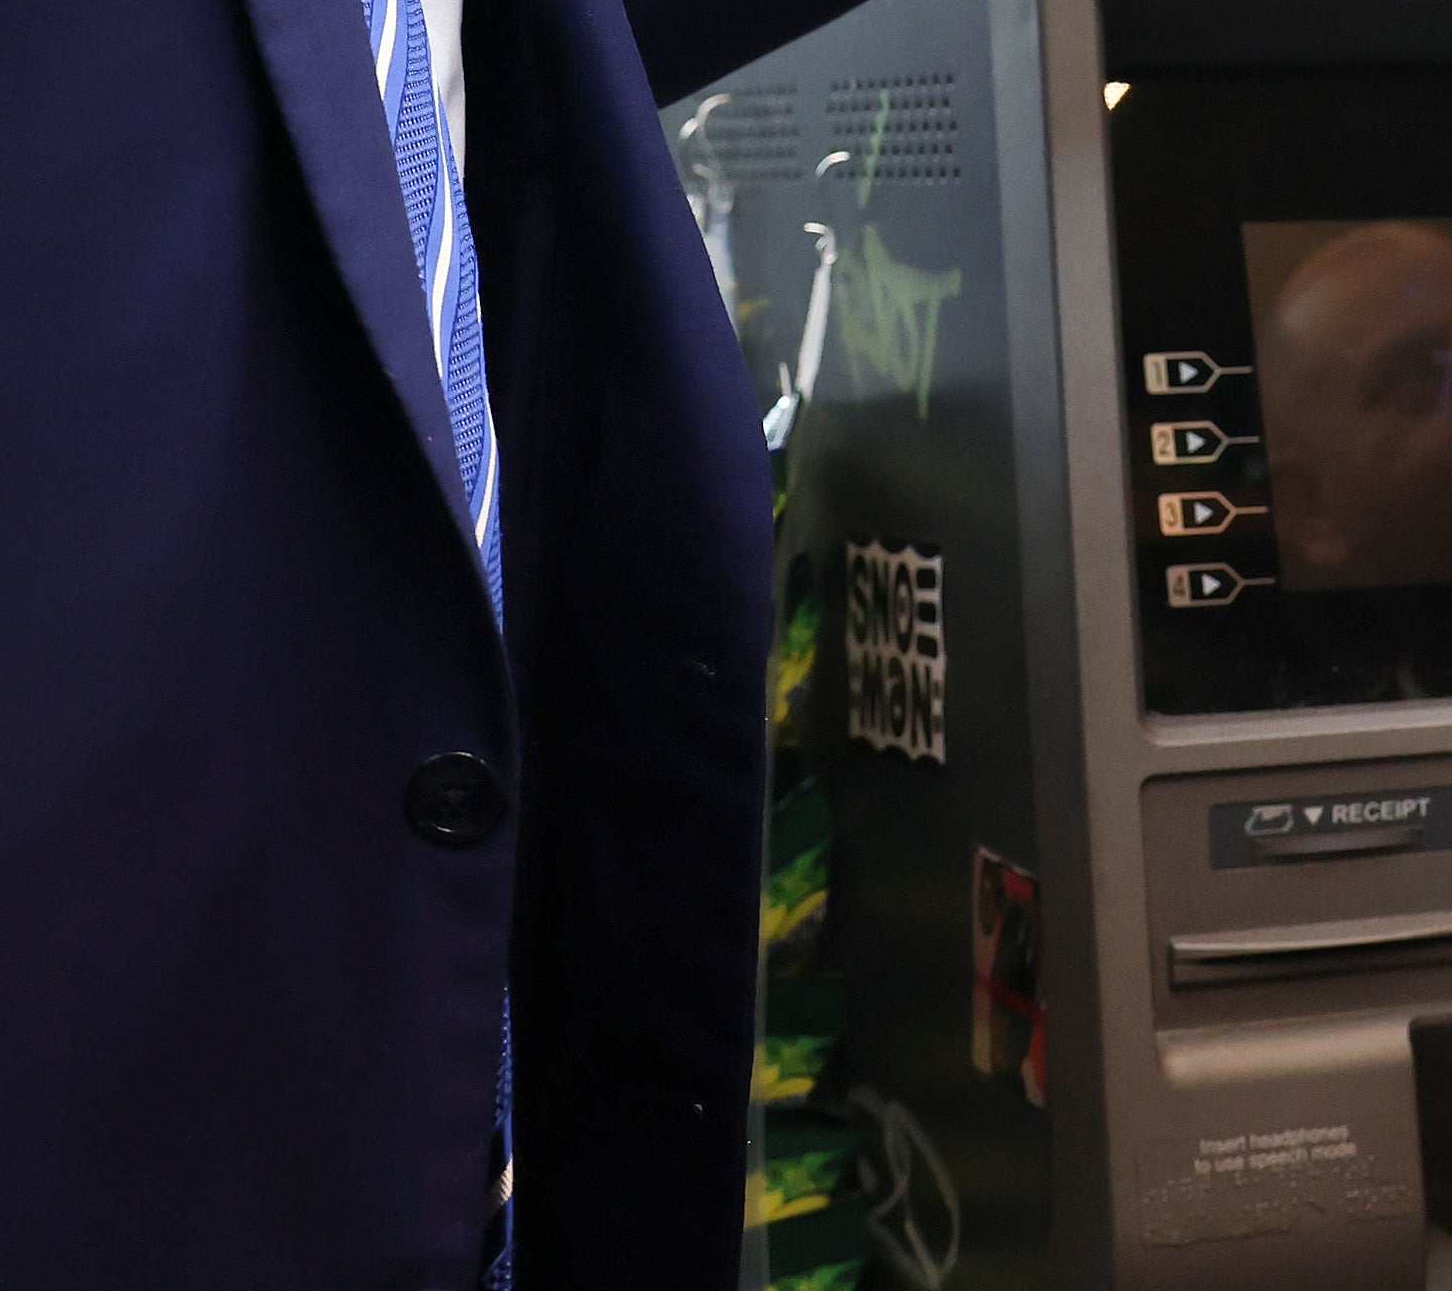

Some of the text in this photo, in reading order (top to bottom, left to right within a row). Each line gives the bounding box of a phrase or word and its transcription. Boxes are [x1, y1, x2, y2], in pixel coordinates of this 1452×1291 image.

[1157, 429, 1170, 457] 2
[1164, 499, 1178, 528] 3
[1331, 796, 1430, 824] RECEIPT
[1199, 1124, 1348, 1155] Insert headphones
[1194, 1141, 1357, 1175] to use speech mode
